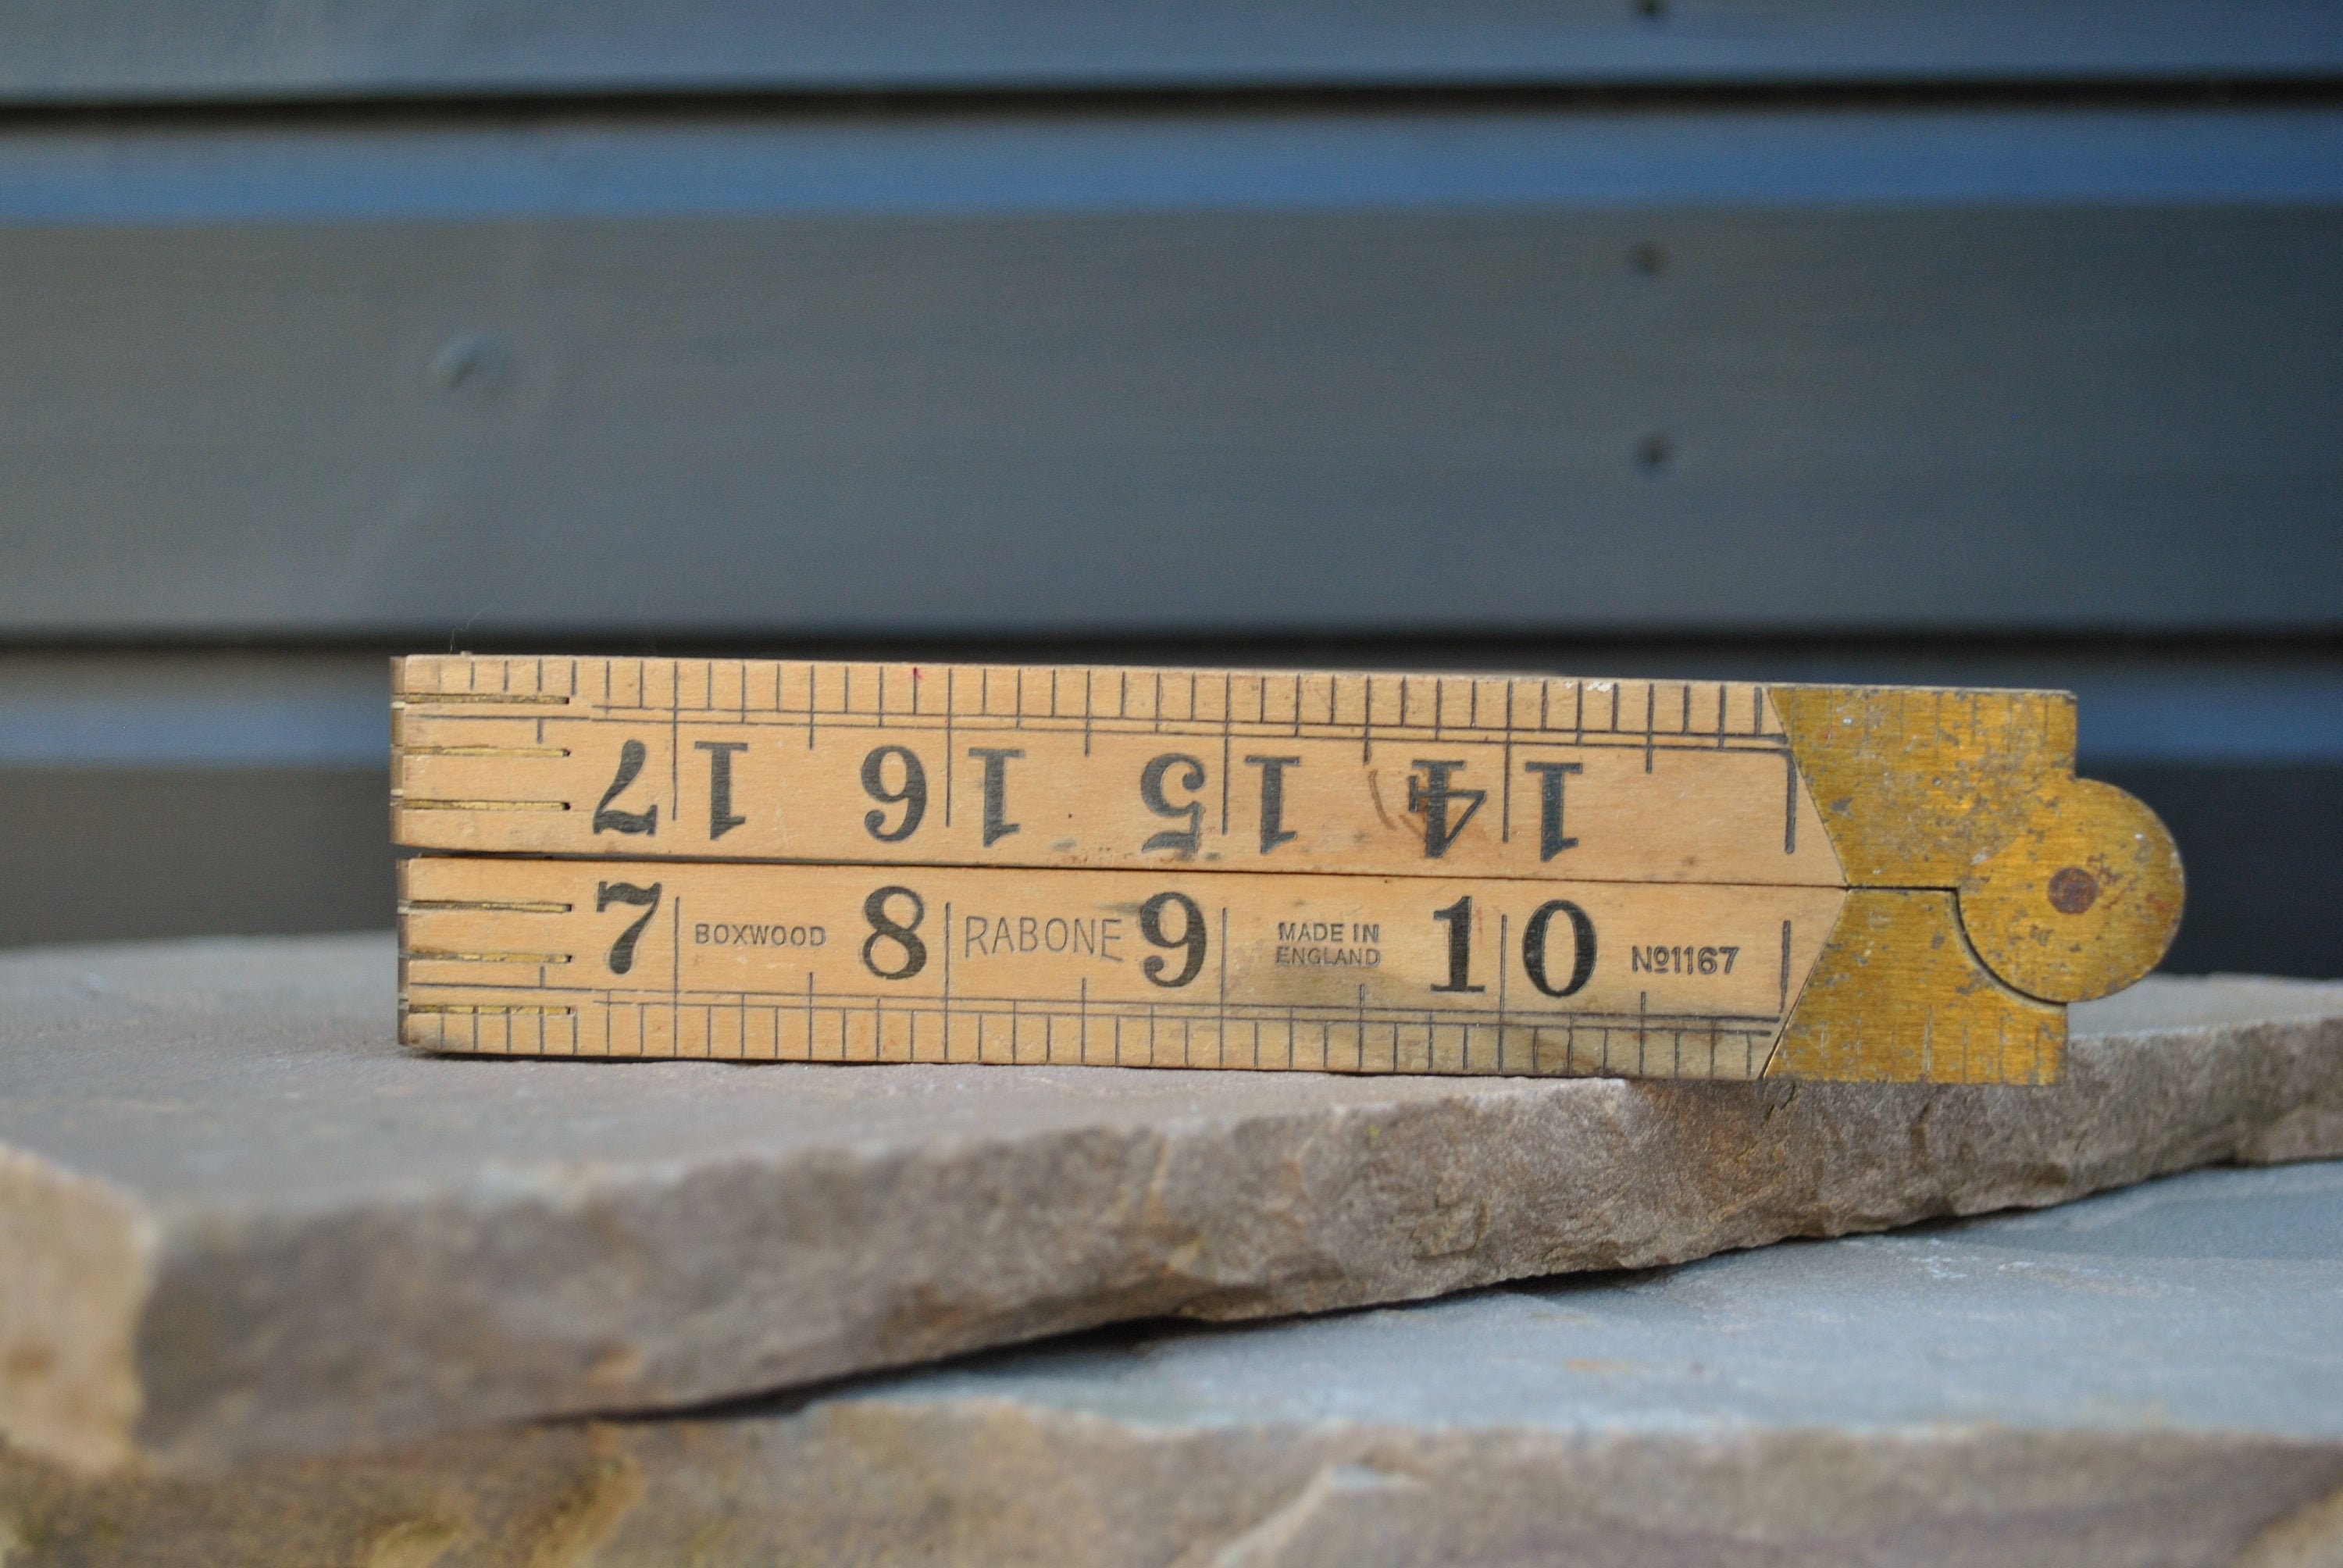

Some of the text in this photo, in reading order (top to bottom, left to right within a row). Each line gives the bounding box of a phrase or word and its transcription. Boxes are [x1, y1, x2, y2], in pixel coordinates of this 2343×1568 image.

[594, 739, 749, 841] 17
[861, 745, 1025, 848] 16
[1140, 752, 1301, 856] 15
[1408, 759, 1583, 862] 14
[596, 881, 662, 976] 7
[694, 923, 826, 947] BOXWOOD
[861, 886, 928, 982] 8
[965, 915, 1124, 961] RABONE
[1140, 891, 1207, 989] 9
[1275, 946, 1381, 968] ENGLAND
[1278, 921, 1380, 945] MADE IN
[1429, 896, 1597, 998] 10
